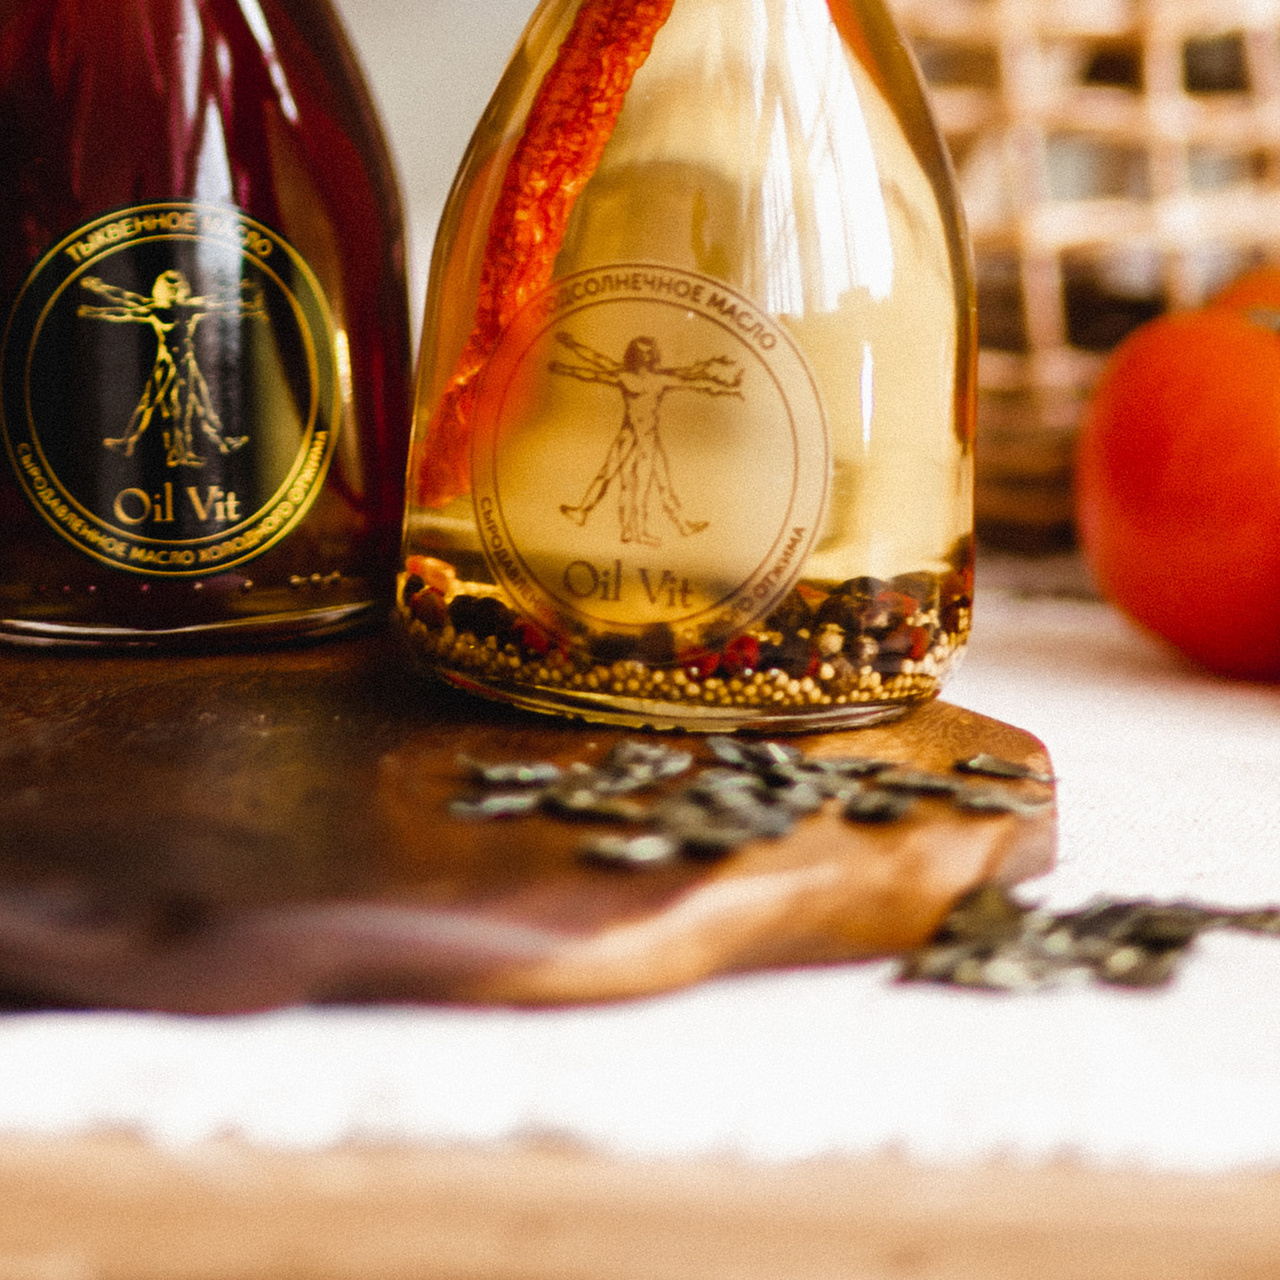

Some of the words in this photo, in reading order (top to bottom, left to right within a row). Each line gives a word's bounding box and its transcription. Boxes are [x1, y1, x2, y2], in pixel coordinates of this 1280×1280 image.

[64, 211, 197, 263] ТЫКВЕННОЕ
[706, 292, 777, 351] МАСЛО
[113, 481, 175, 526] Oil
[186, 485, 242, 522] Vit
[129, 545, 196, 566] МАСЛО
[563, 558, 622, 600] Oil
[638, 567, 694, 609] Vit
